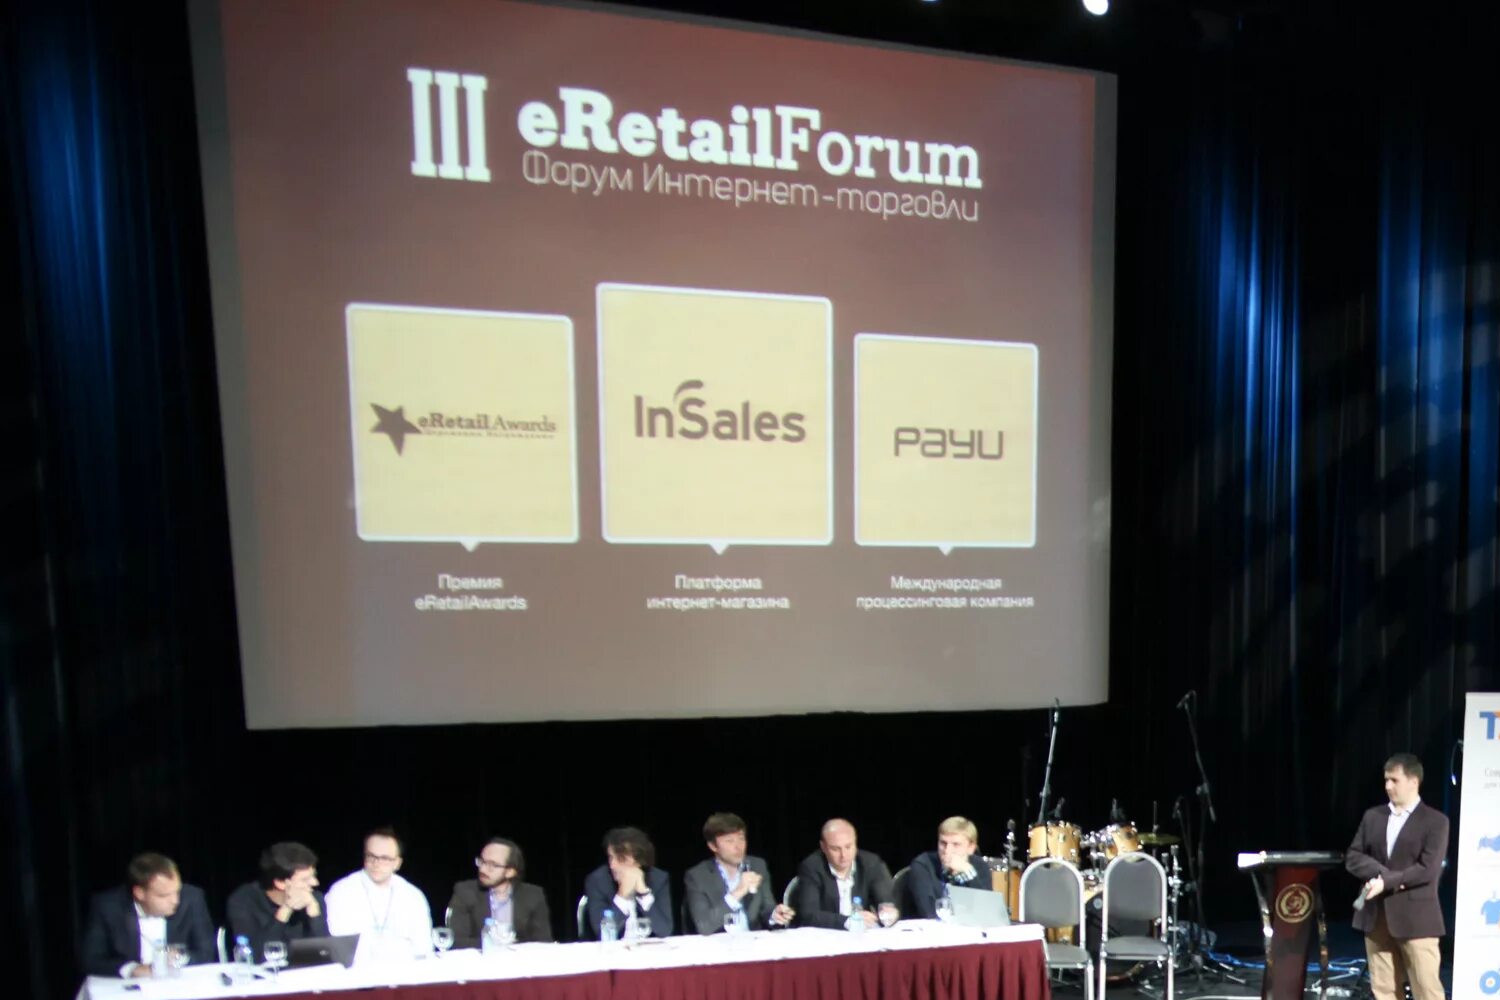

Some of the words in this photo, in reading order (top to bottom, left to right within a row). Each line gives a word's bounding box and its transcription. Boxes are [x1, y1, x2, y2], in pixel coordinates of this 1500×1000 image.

[407, 68, 491, 182] III
[517, 87, 983, 188] eRetailForum
[522, 150, 633, 195] Форум
[643, 163, 979, 221] Интернет-торговли
[633, 379, 806, 444] InSales
[438, 574, 503, 591] Премия
[675, 574, 762, 593] Платформа
[891, 576, 1002, 592] Международная
[415, 595, 527, 610] eRetailAwards
[647, 597, 789, 611] интернет-магазина
[856, 597, 968, 610] процессинговая
[971, 597, 1034, 608] компания
